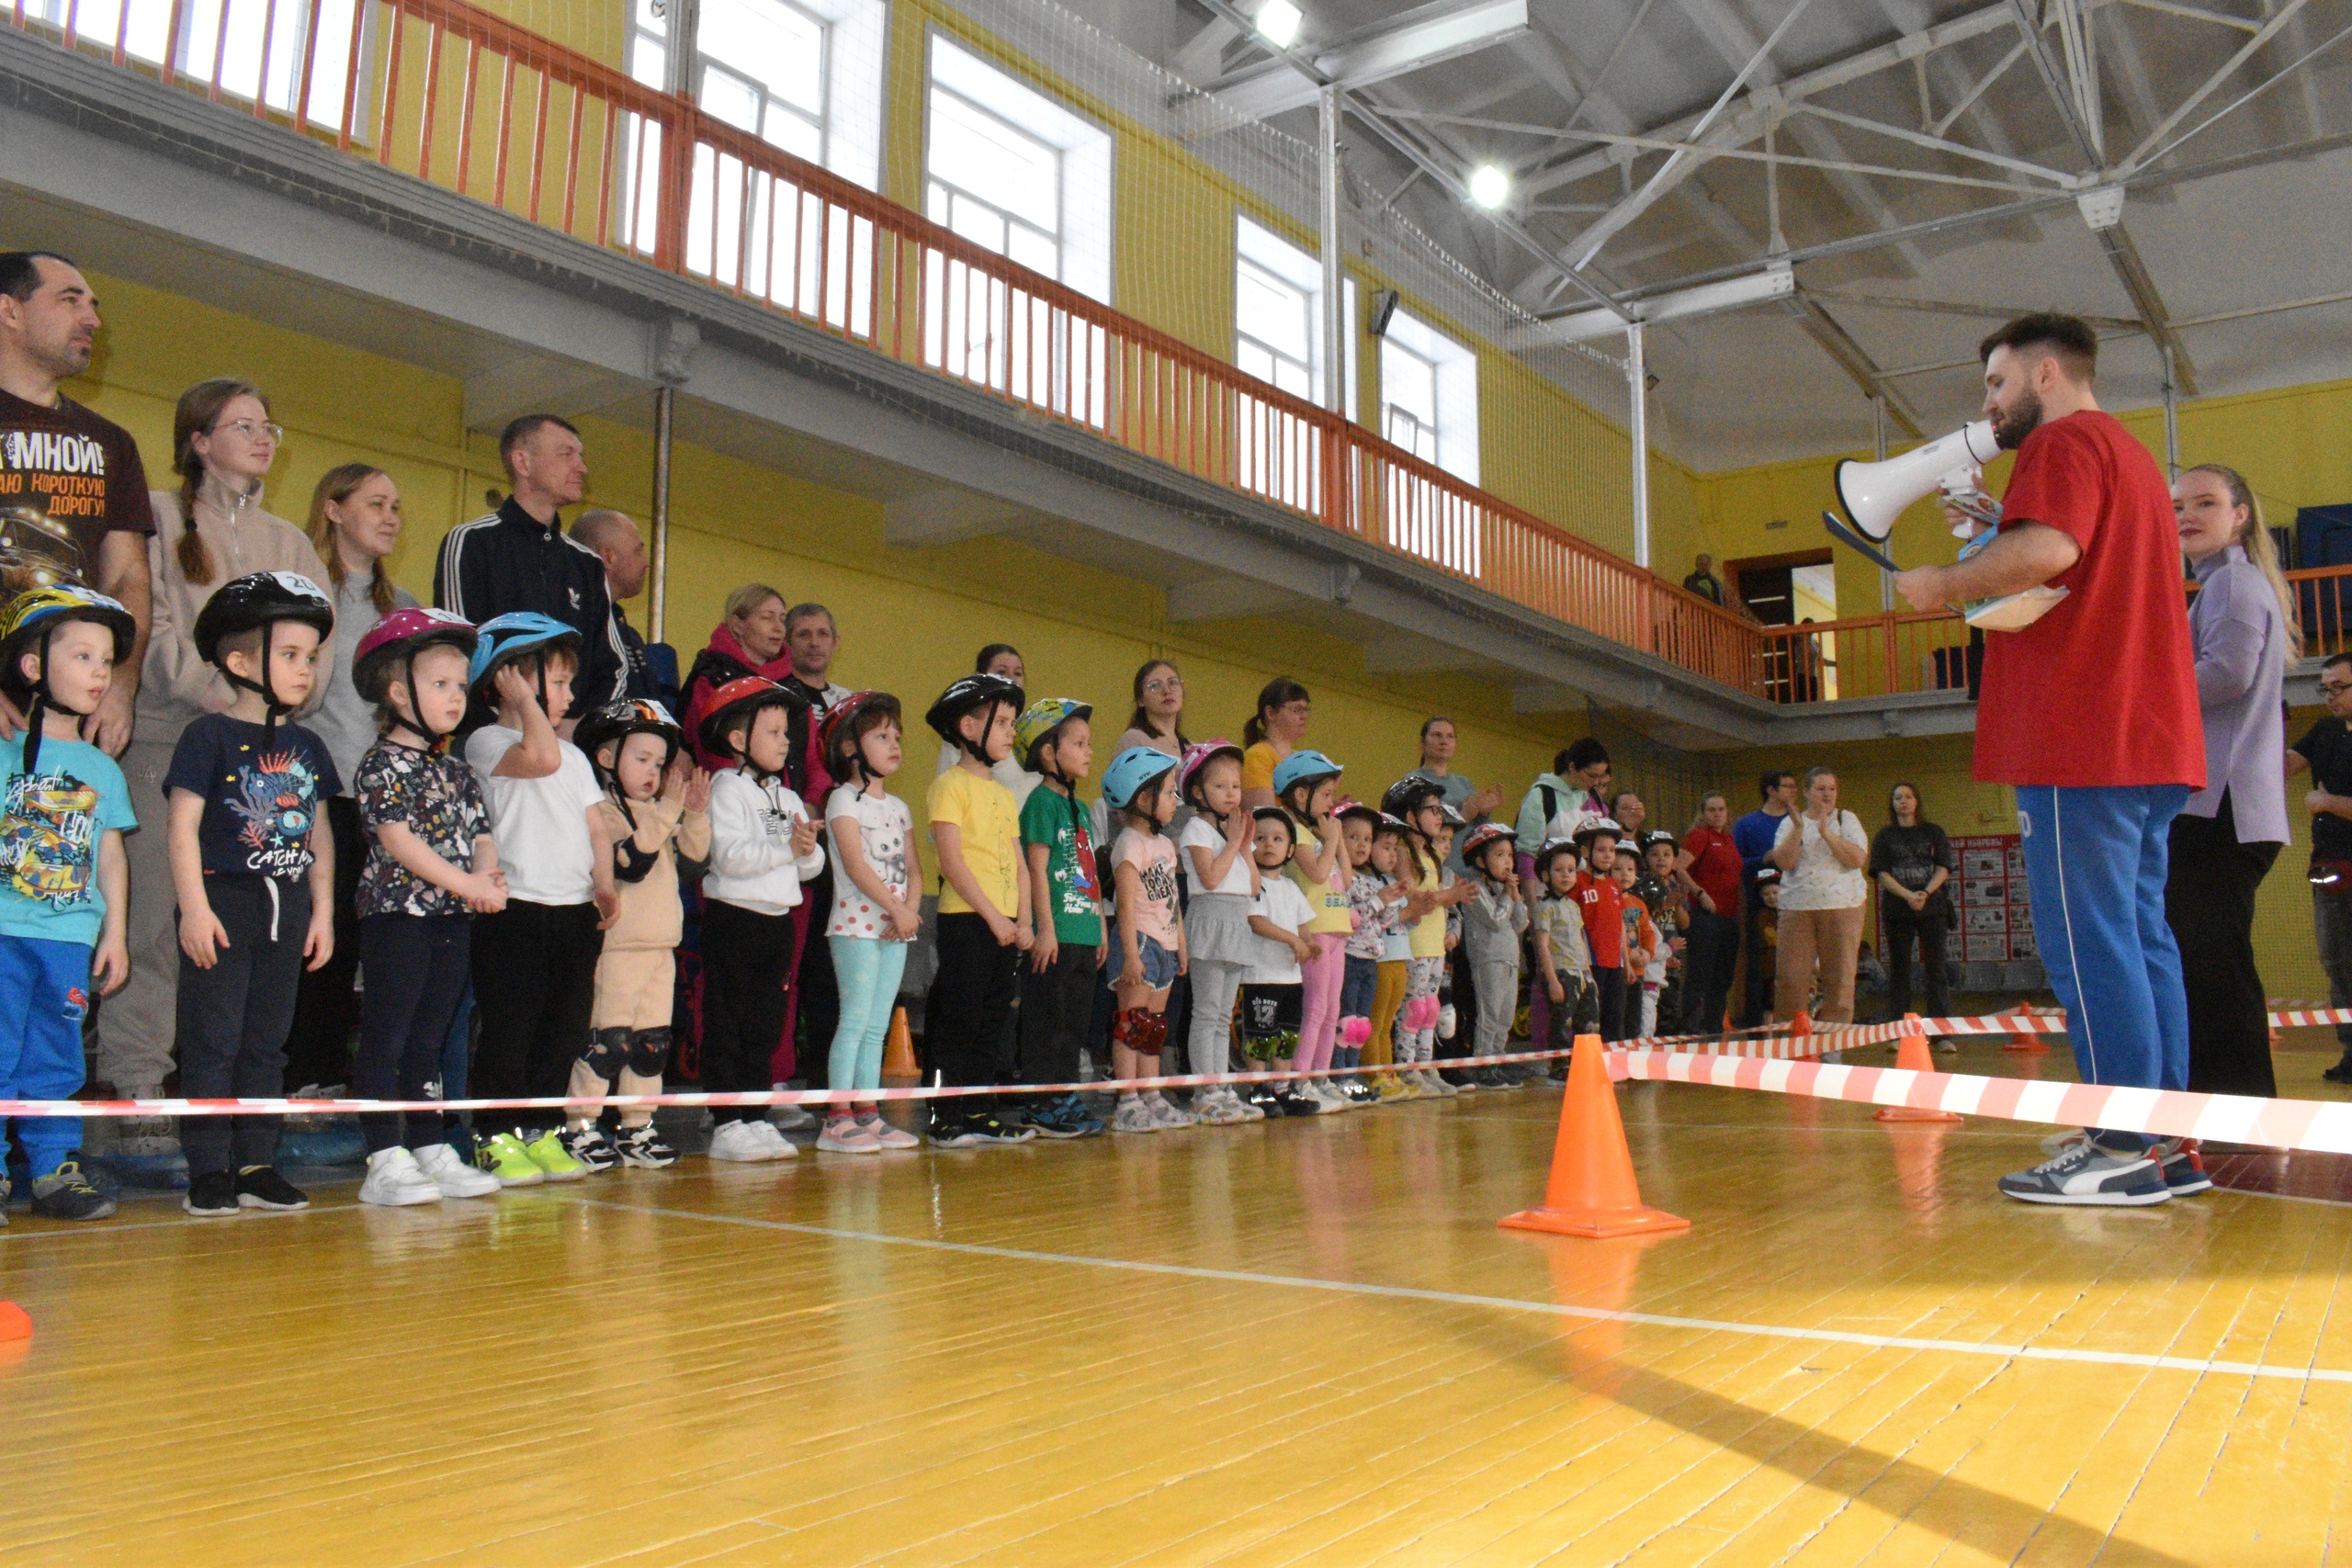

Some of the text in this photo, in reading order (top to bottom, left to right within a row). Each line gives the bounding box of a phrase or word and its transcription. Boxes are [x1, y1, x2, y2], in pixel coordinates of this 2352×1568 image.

[12, 432, 106, 476] МНОЙ!
[31, 472, 106, 497] КОРОТКУЮ
[46, 494, 106, 517] ДОРОГУ!
[246, 849, 300, 870] CATCH
[1581, 888, 1599, 904] 10
